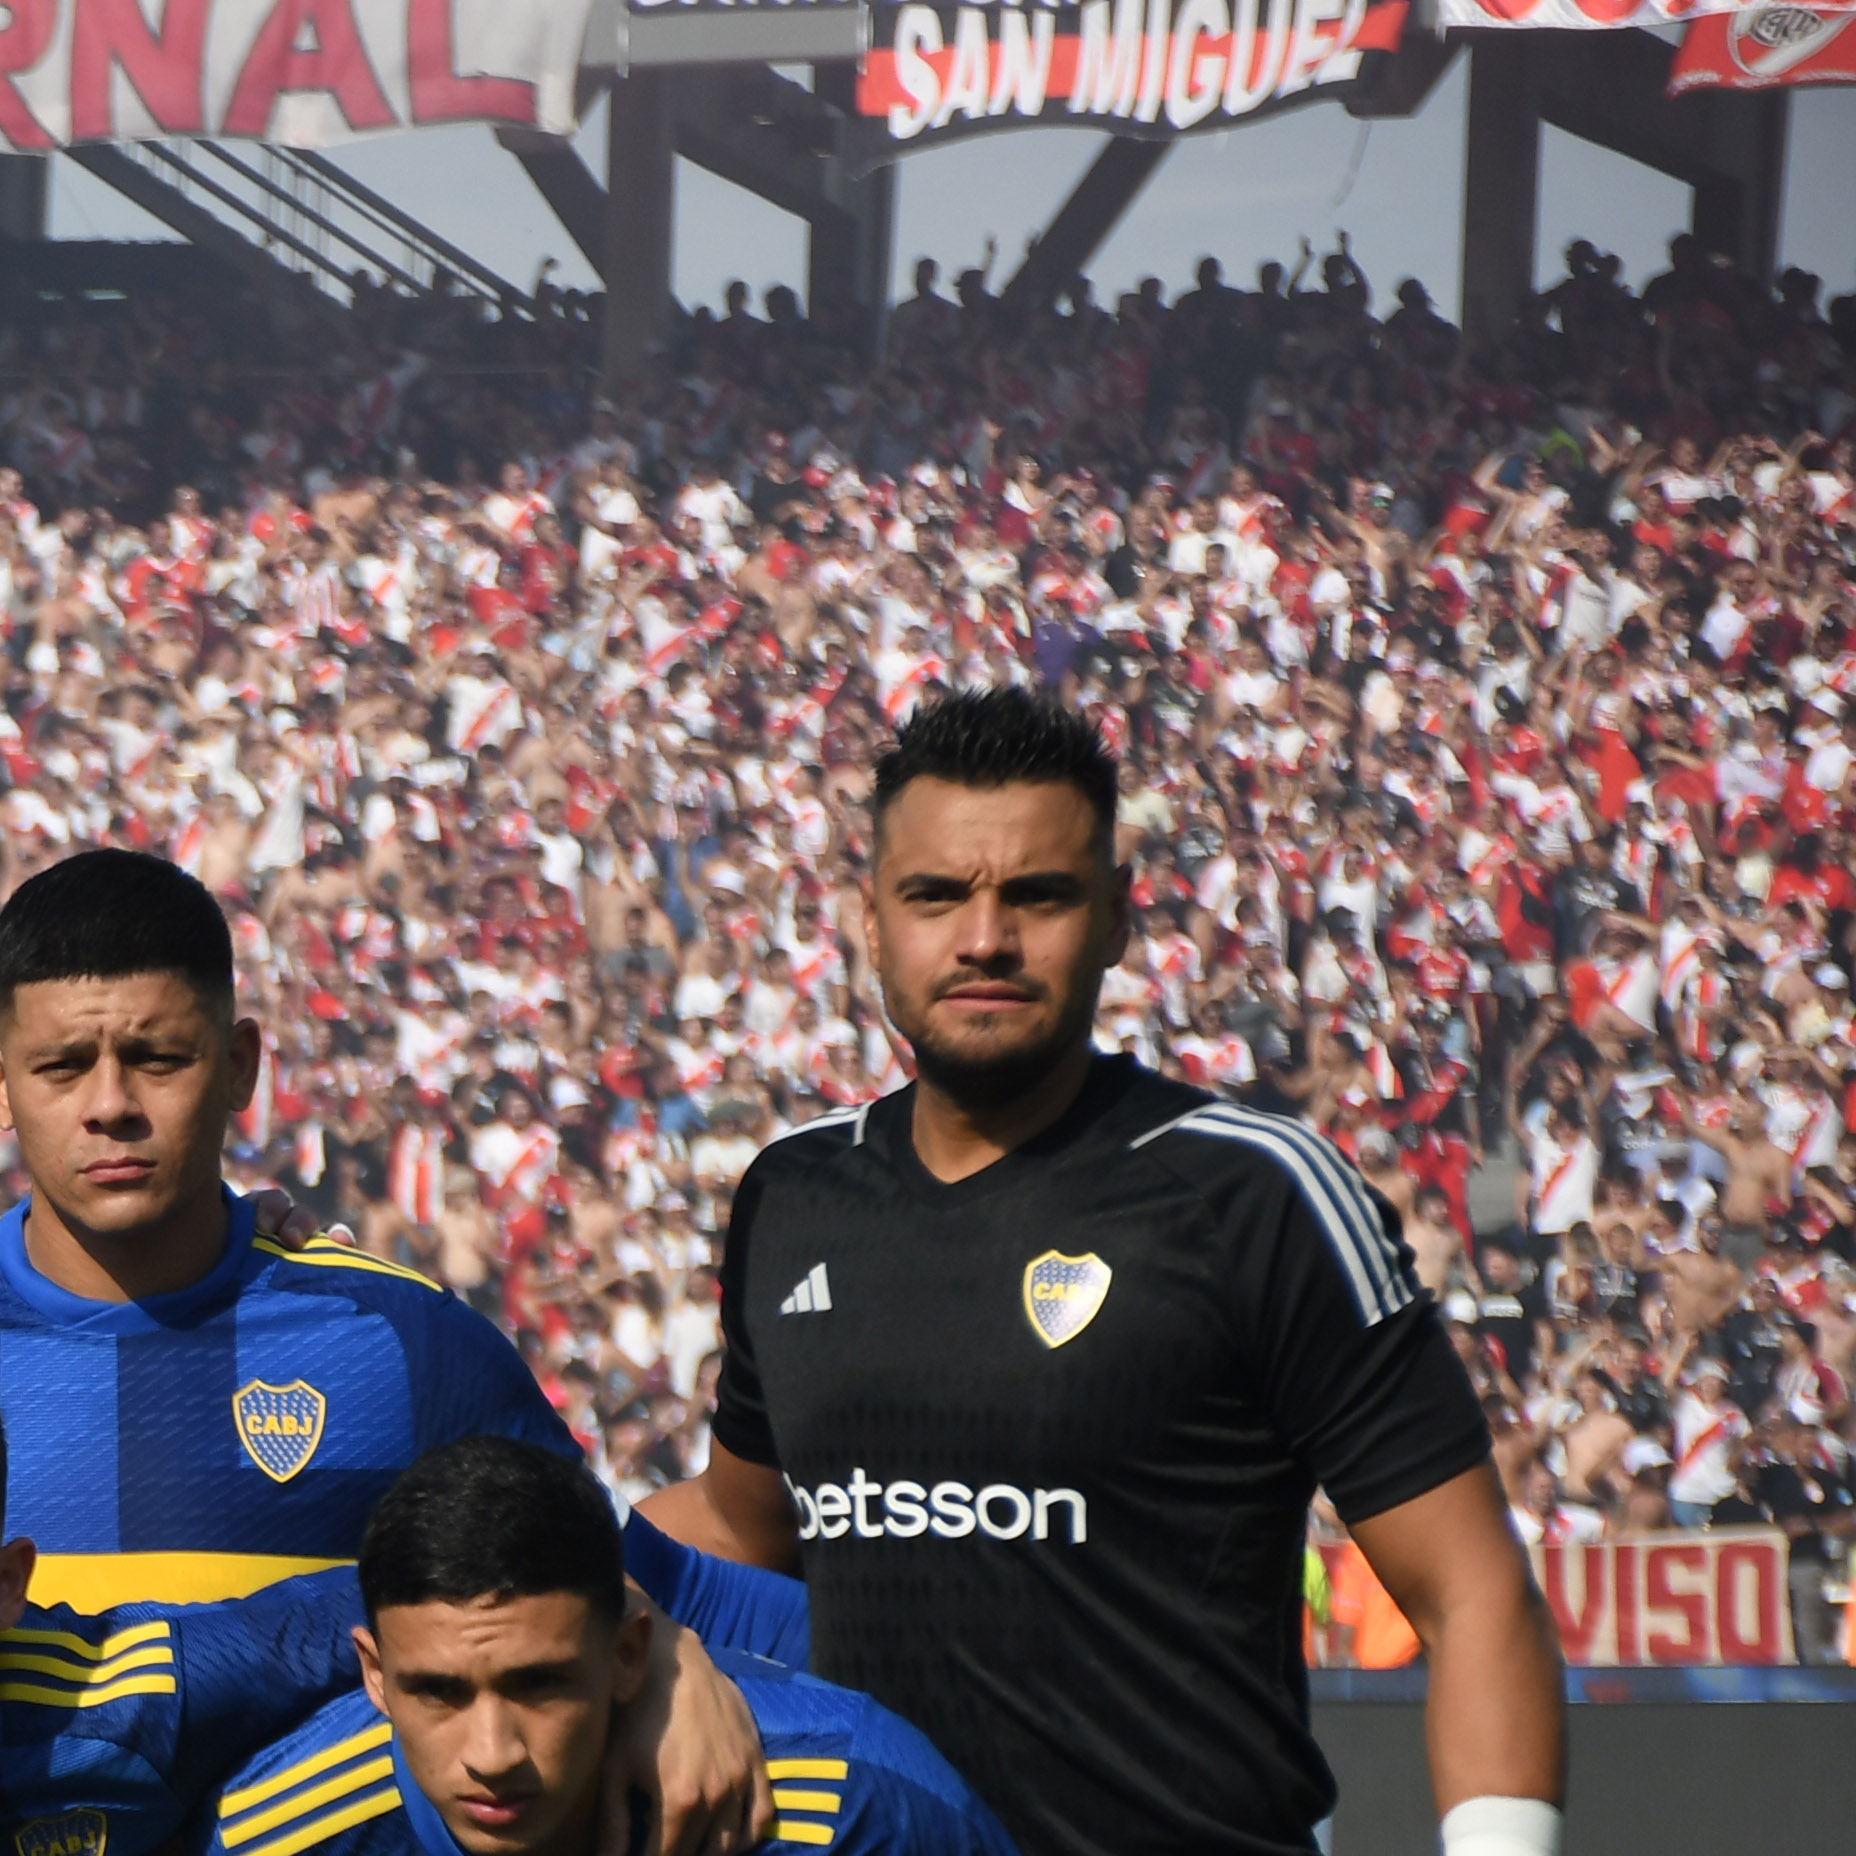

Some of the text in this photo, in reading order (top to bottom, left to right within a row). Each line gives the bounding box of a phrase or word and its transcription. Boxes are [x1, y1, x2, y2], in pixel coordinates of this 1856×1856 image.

[889, 0, 1366, 139] SAN MIGUEL
[245, 1412, 314, 1437] CABJ
